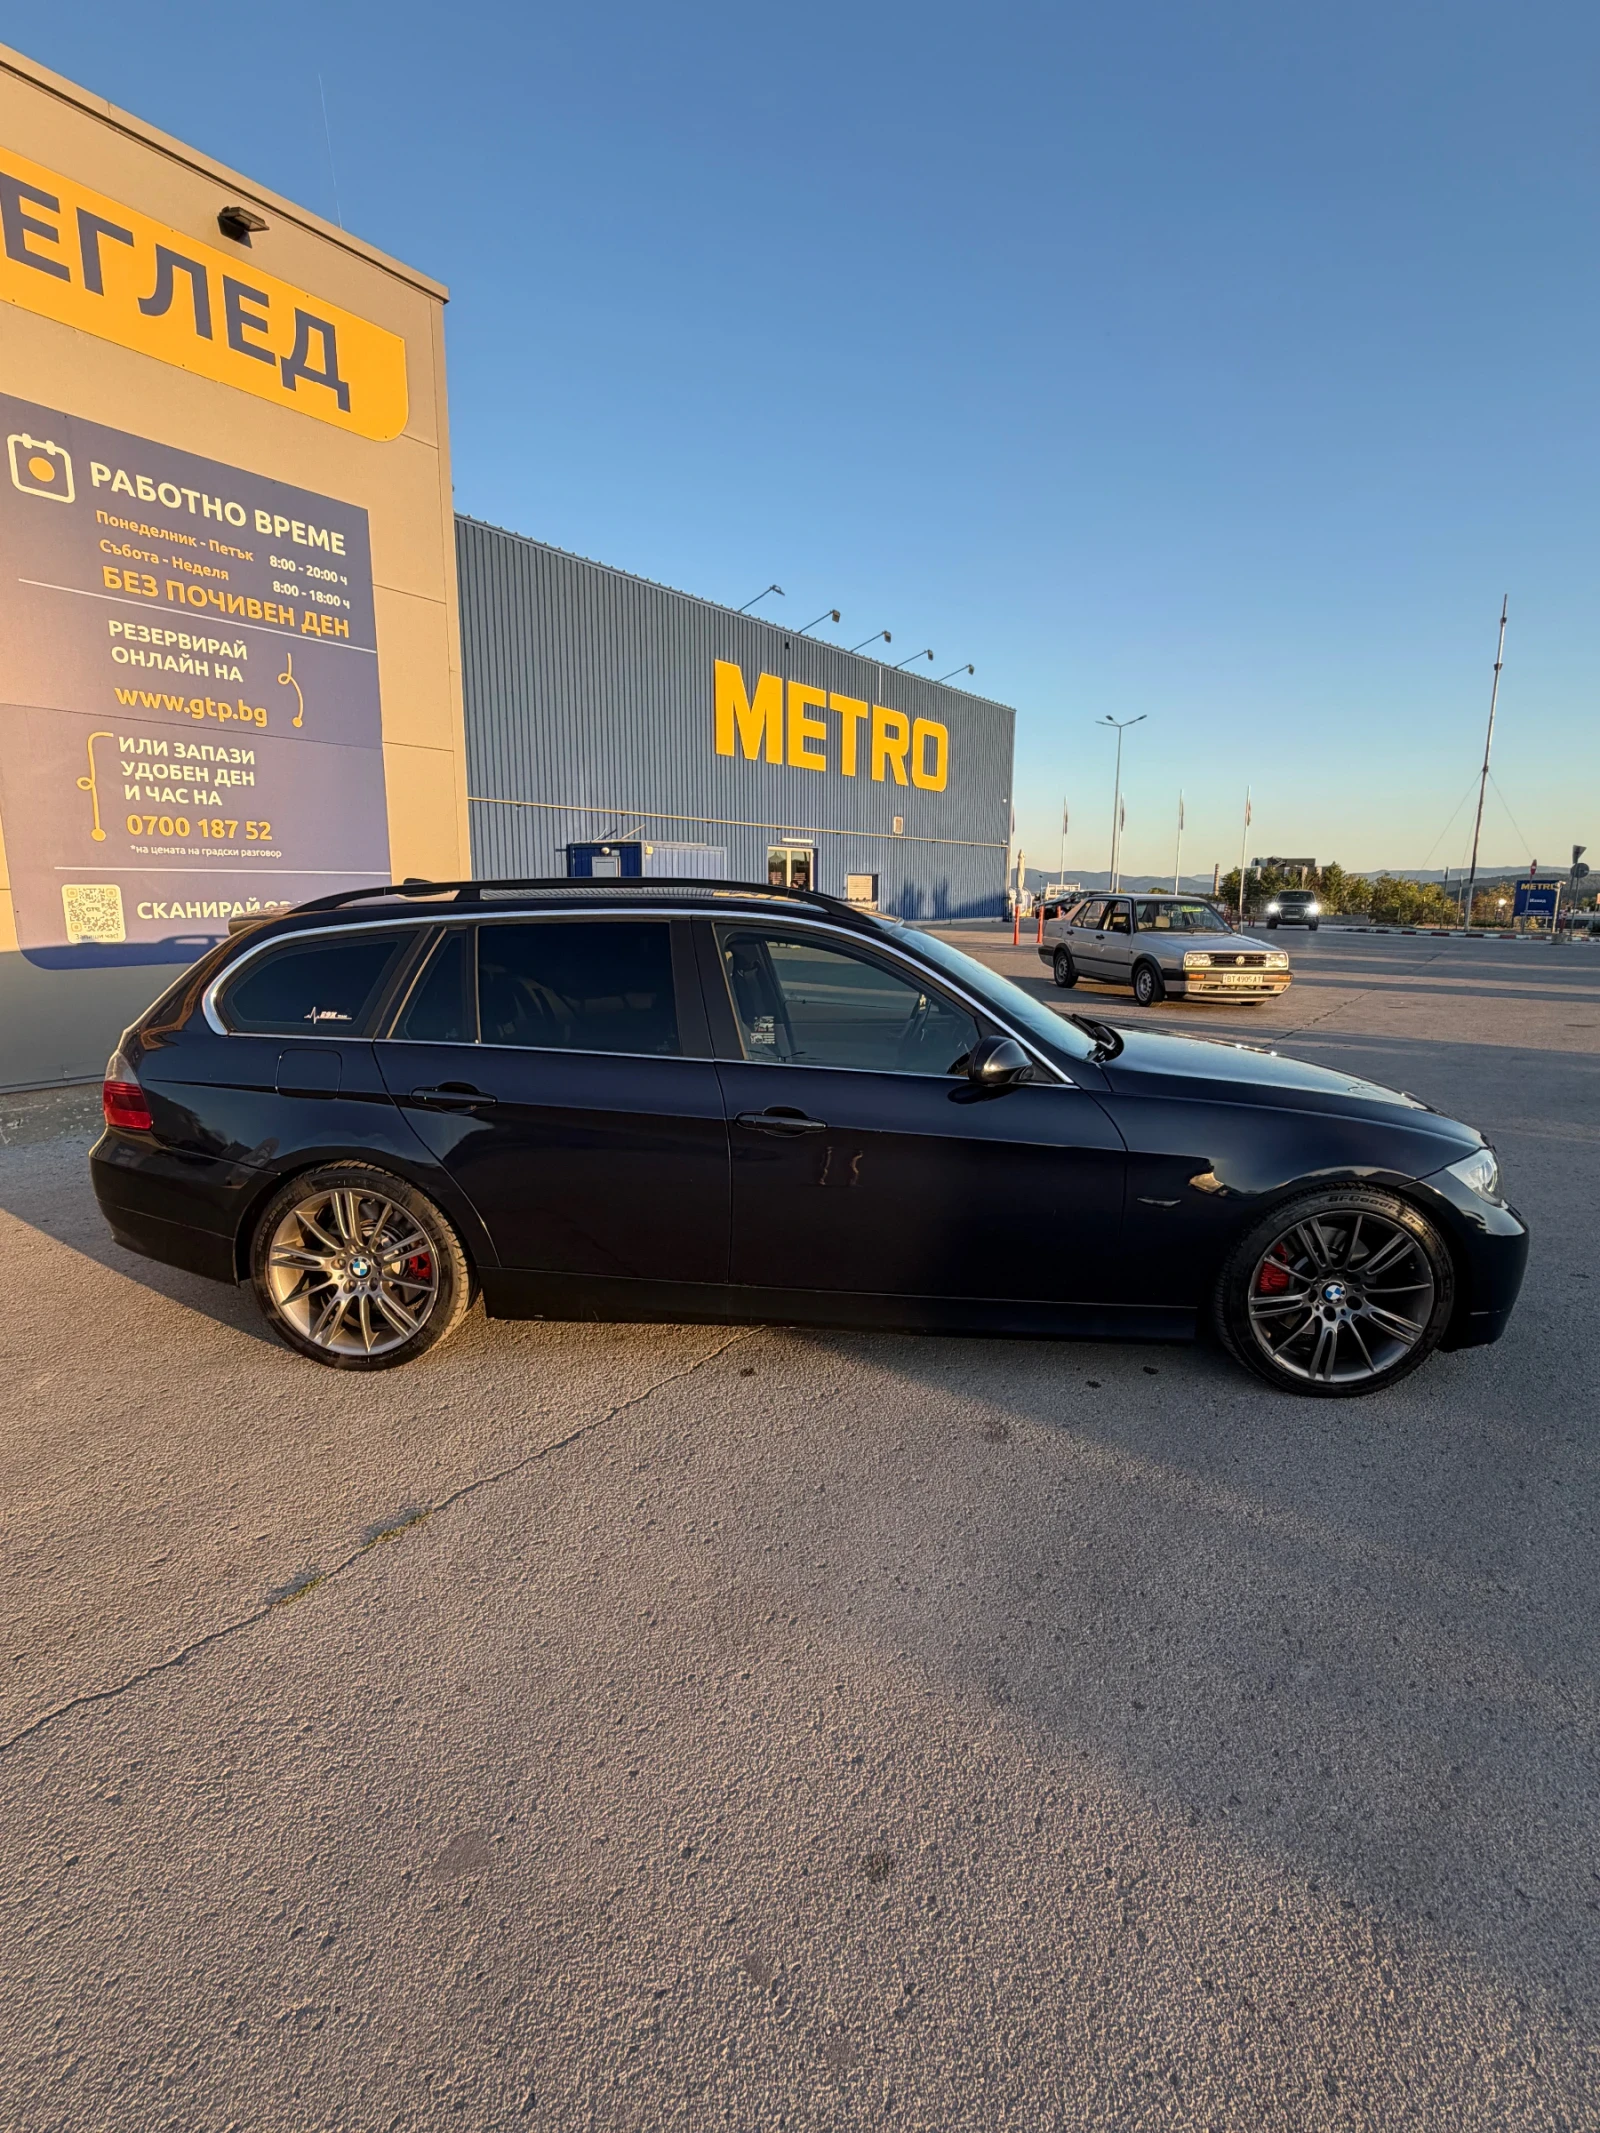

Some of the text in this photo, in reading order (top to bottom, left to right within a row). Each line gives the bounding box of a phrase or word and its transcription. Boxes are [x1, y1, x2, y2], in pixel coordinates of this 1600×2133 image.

[0, 172, 351, 413] ЕГЛЕД
[90, 461, 346, 556] РАБОТНО ВРЕМЕ
[96, 509, 197, 548] Понеделник
[209, 539, 254, 562] Петък
[99, 539, 159, 564] Събота
[171, 556, 229, 581] Неделя
[269, 555, 296, 572] 8:00
[306, 565, 338, 583] 20:00
[340, 576, 348, 586] ч
[102, 565, 350, 639] БЕЗ ПОЧИВЕН ДЕН
[273, 581, 299, 597] 8:00
[309, 590, 341, 607] 18:00
[343, 600, 350, 609] ч
[108, 619, 248, 661] РЕЗЕРВИРАЙ
[111, 646, 244, 683] ОНЛАЙН НА
[114, 687, 268, 728] www.gtp.bg
[713, 659, 949, 793] METRO
[118, 736, 255, 765] ИЛИ ЗАПАЗИ
[120, 760, 255, 788] УДОБЕН ДЕН
[124, 784, 223, 806] И ЧАС НА
[126, 814, 273, 841] 0700 187 52
[150, 847, 186, 856] цената
[201, 848, 239, 857] градски
[241, 850, 282, 858] разговор
[137, 897, 260, 919] СКАНИРАЙ
